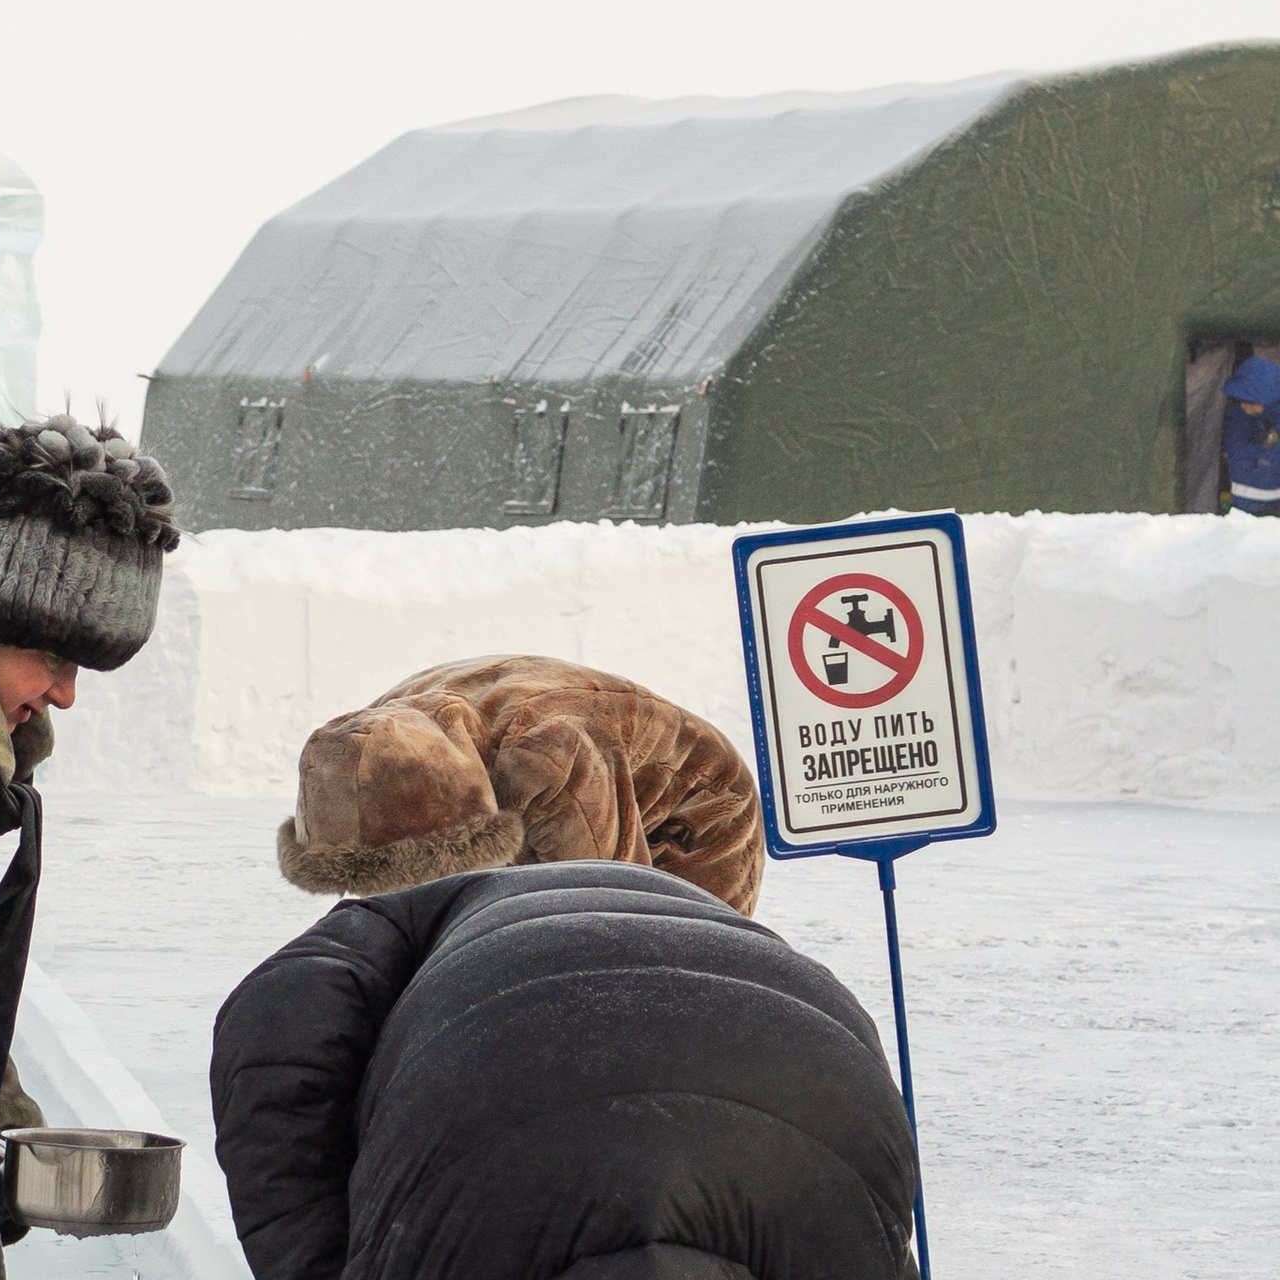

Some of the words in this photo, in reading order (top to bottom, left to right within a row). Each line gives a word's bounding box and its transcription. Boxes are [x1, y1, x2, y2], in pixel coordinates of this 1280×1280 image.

[798, 718, 862, 748] ВОДУ
[874, 711, 935, 739] ПИТЬ
[802, 739, 939, 782] ЗАПРЕЩЕНО
[795, 789, 843, 804] ТОЛЬКО
[846, 786, 870, 799] ДЛЯ
[874, 776, 949, 794] НАРУЖНОГО
[821, 795, 905, 814] ПРИМЕНЕНИЯ
